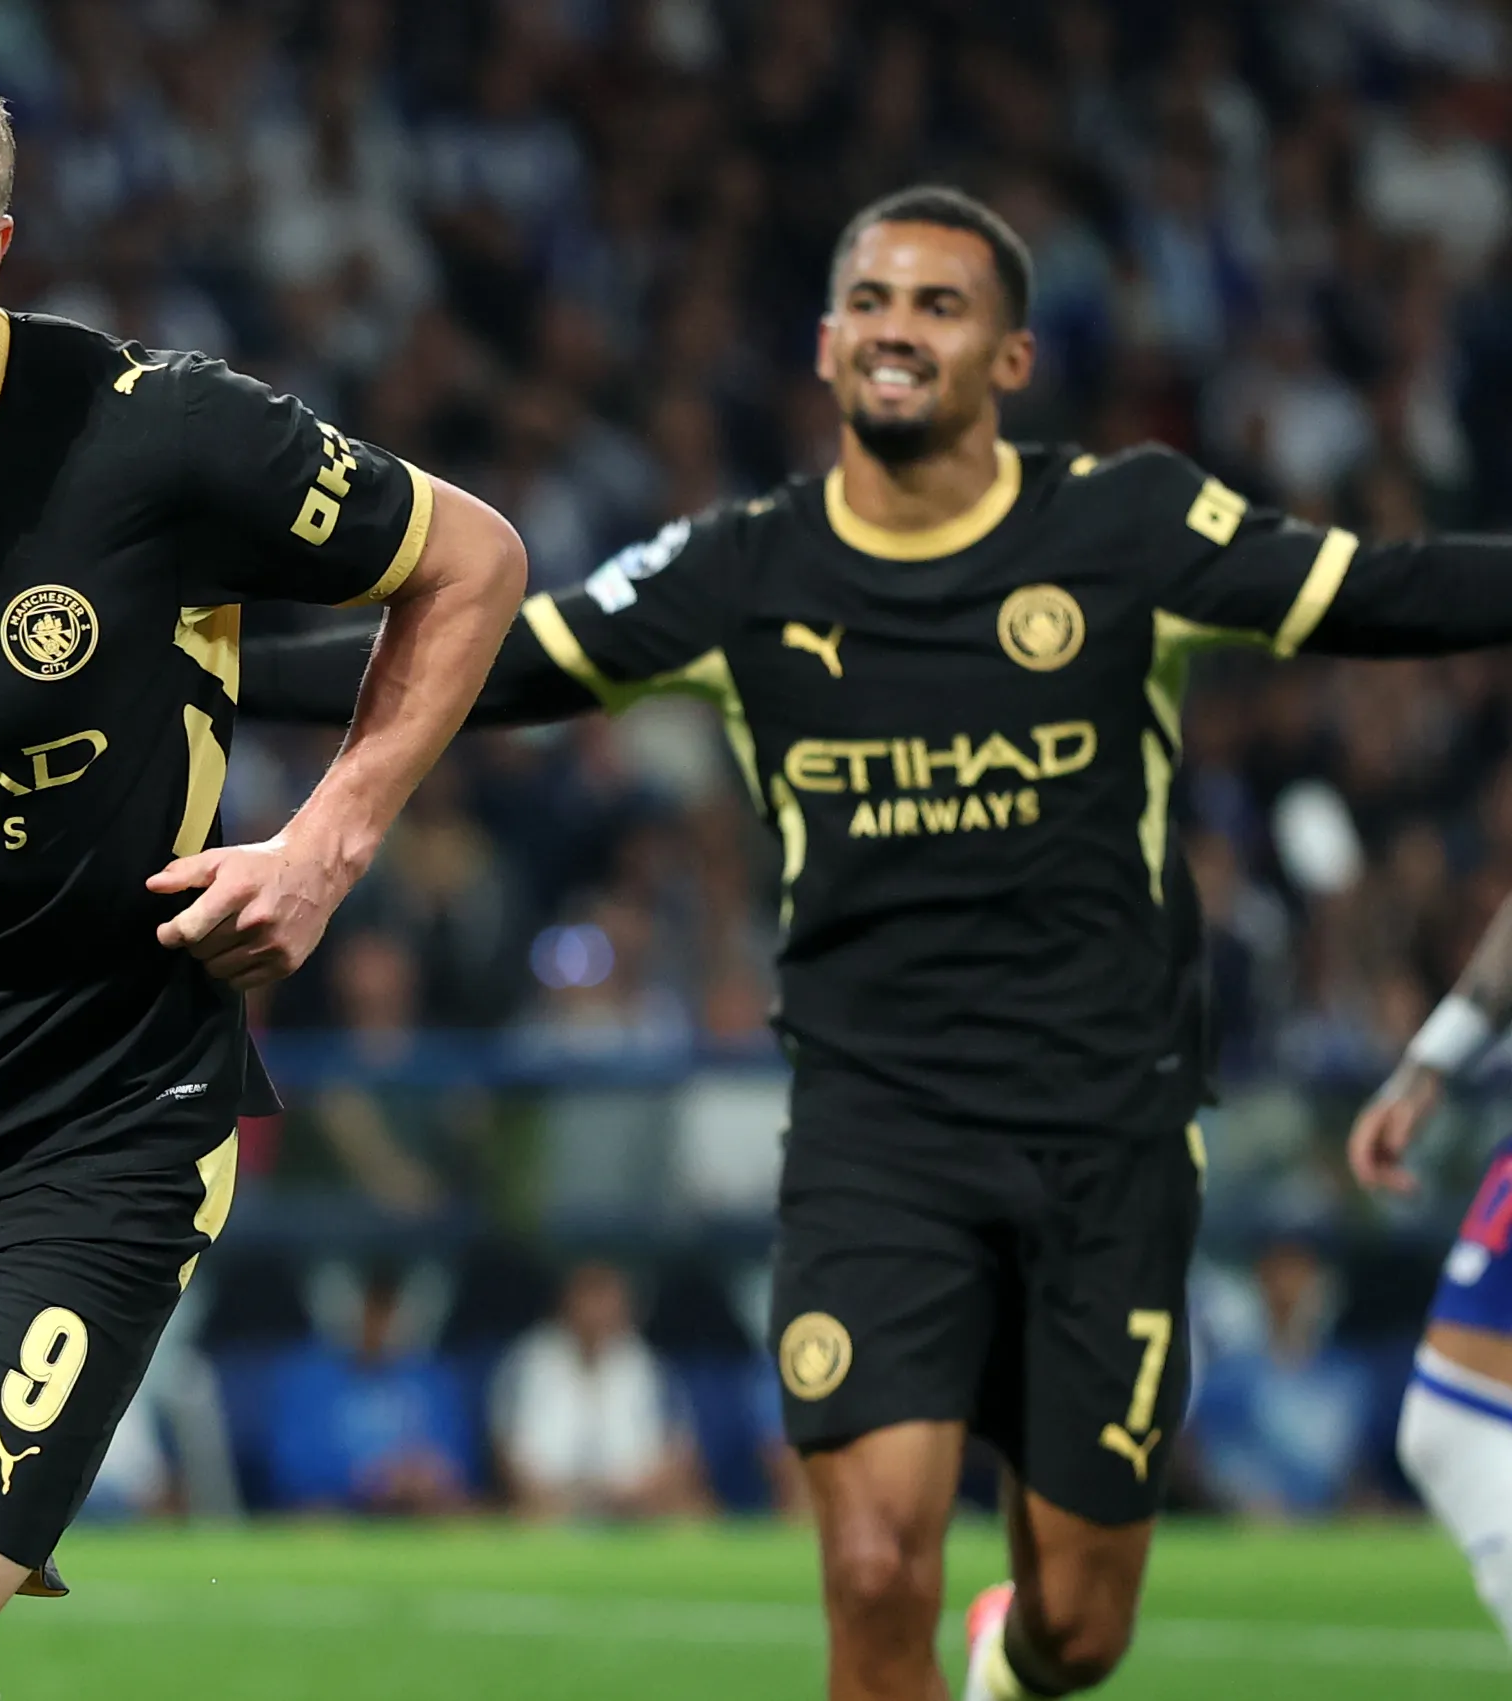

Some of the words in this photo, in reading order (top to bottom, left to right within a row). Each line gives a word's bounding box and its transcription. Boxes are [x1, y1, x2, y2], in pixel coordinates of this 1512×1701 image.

[10, 592, 85, 626] MANCHESTER
[41, 661, 69, 674] CITY
[784, 720, 1098, 793] ETIHAD
[848, 788, 1040, 840] AIRWAYS
[0, 1306, 89, 1433] 9
[1125, 1308, 1173, 1434] 7
